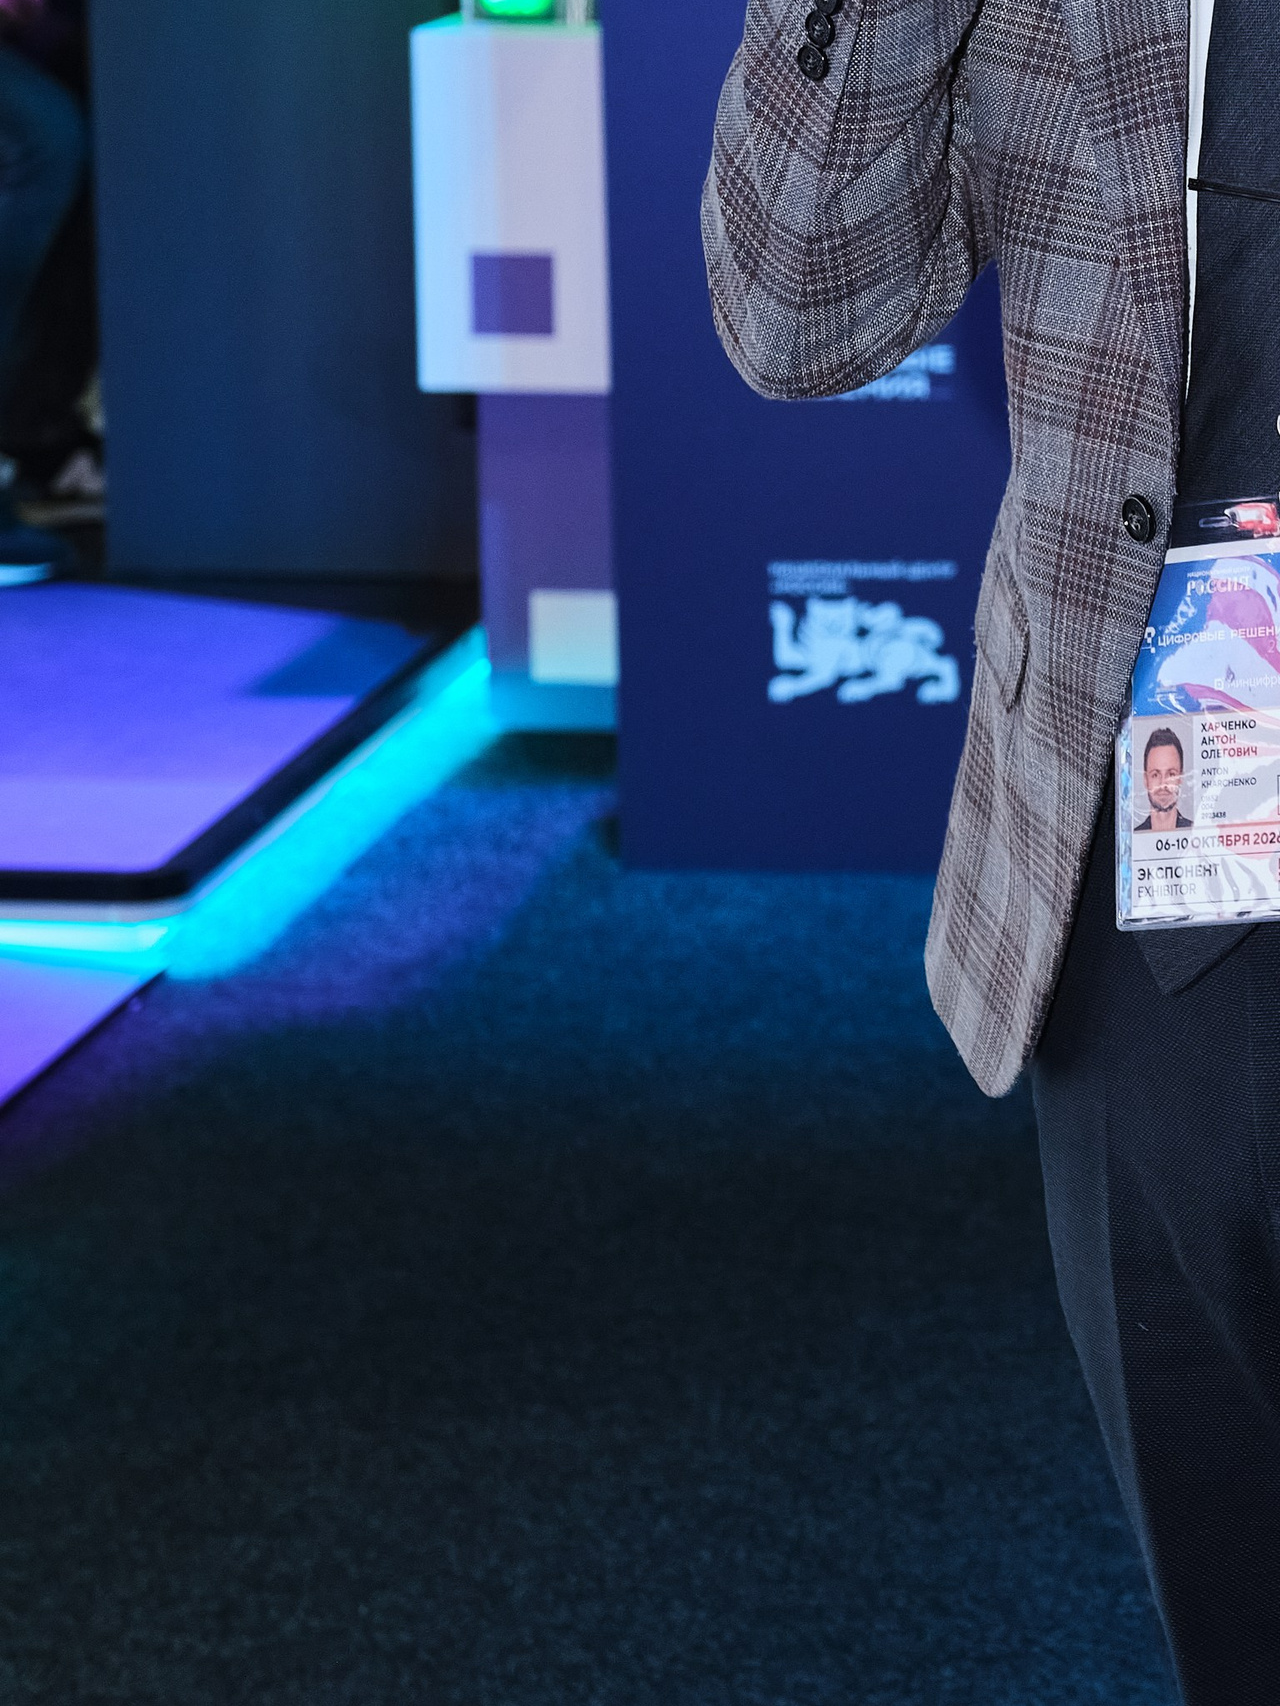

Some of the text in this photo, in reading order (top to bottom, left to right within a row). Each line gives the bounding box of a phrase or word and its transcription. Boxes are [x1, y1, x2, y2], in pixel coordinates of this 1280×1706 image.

[1186, 575, 1251, 596] РОССИЯ
[1158, 629, 1225, 647] ЦИФРОВЫЕ
[1201, 719, 1257, 732] ХАРЧЕНКО
[1201, 734, 1237, 746] АНТОН
[1201, 746, 1258, 759] ОЛЕГОВИЧ
[1201, 767, 1229, 776] ANTON
[1201, 777, 1257, 789] KHARCHENKO
[1156, 837, 1189, 852] 06-10
[1191, 833, 1250, 850] ОКТЯБРЯ
[1137, 863, 1220, 881] ЭКСПОНЕНТ
[1138, 883, 1197, 898] EXHIBITOR
